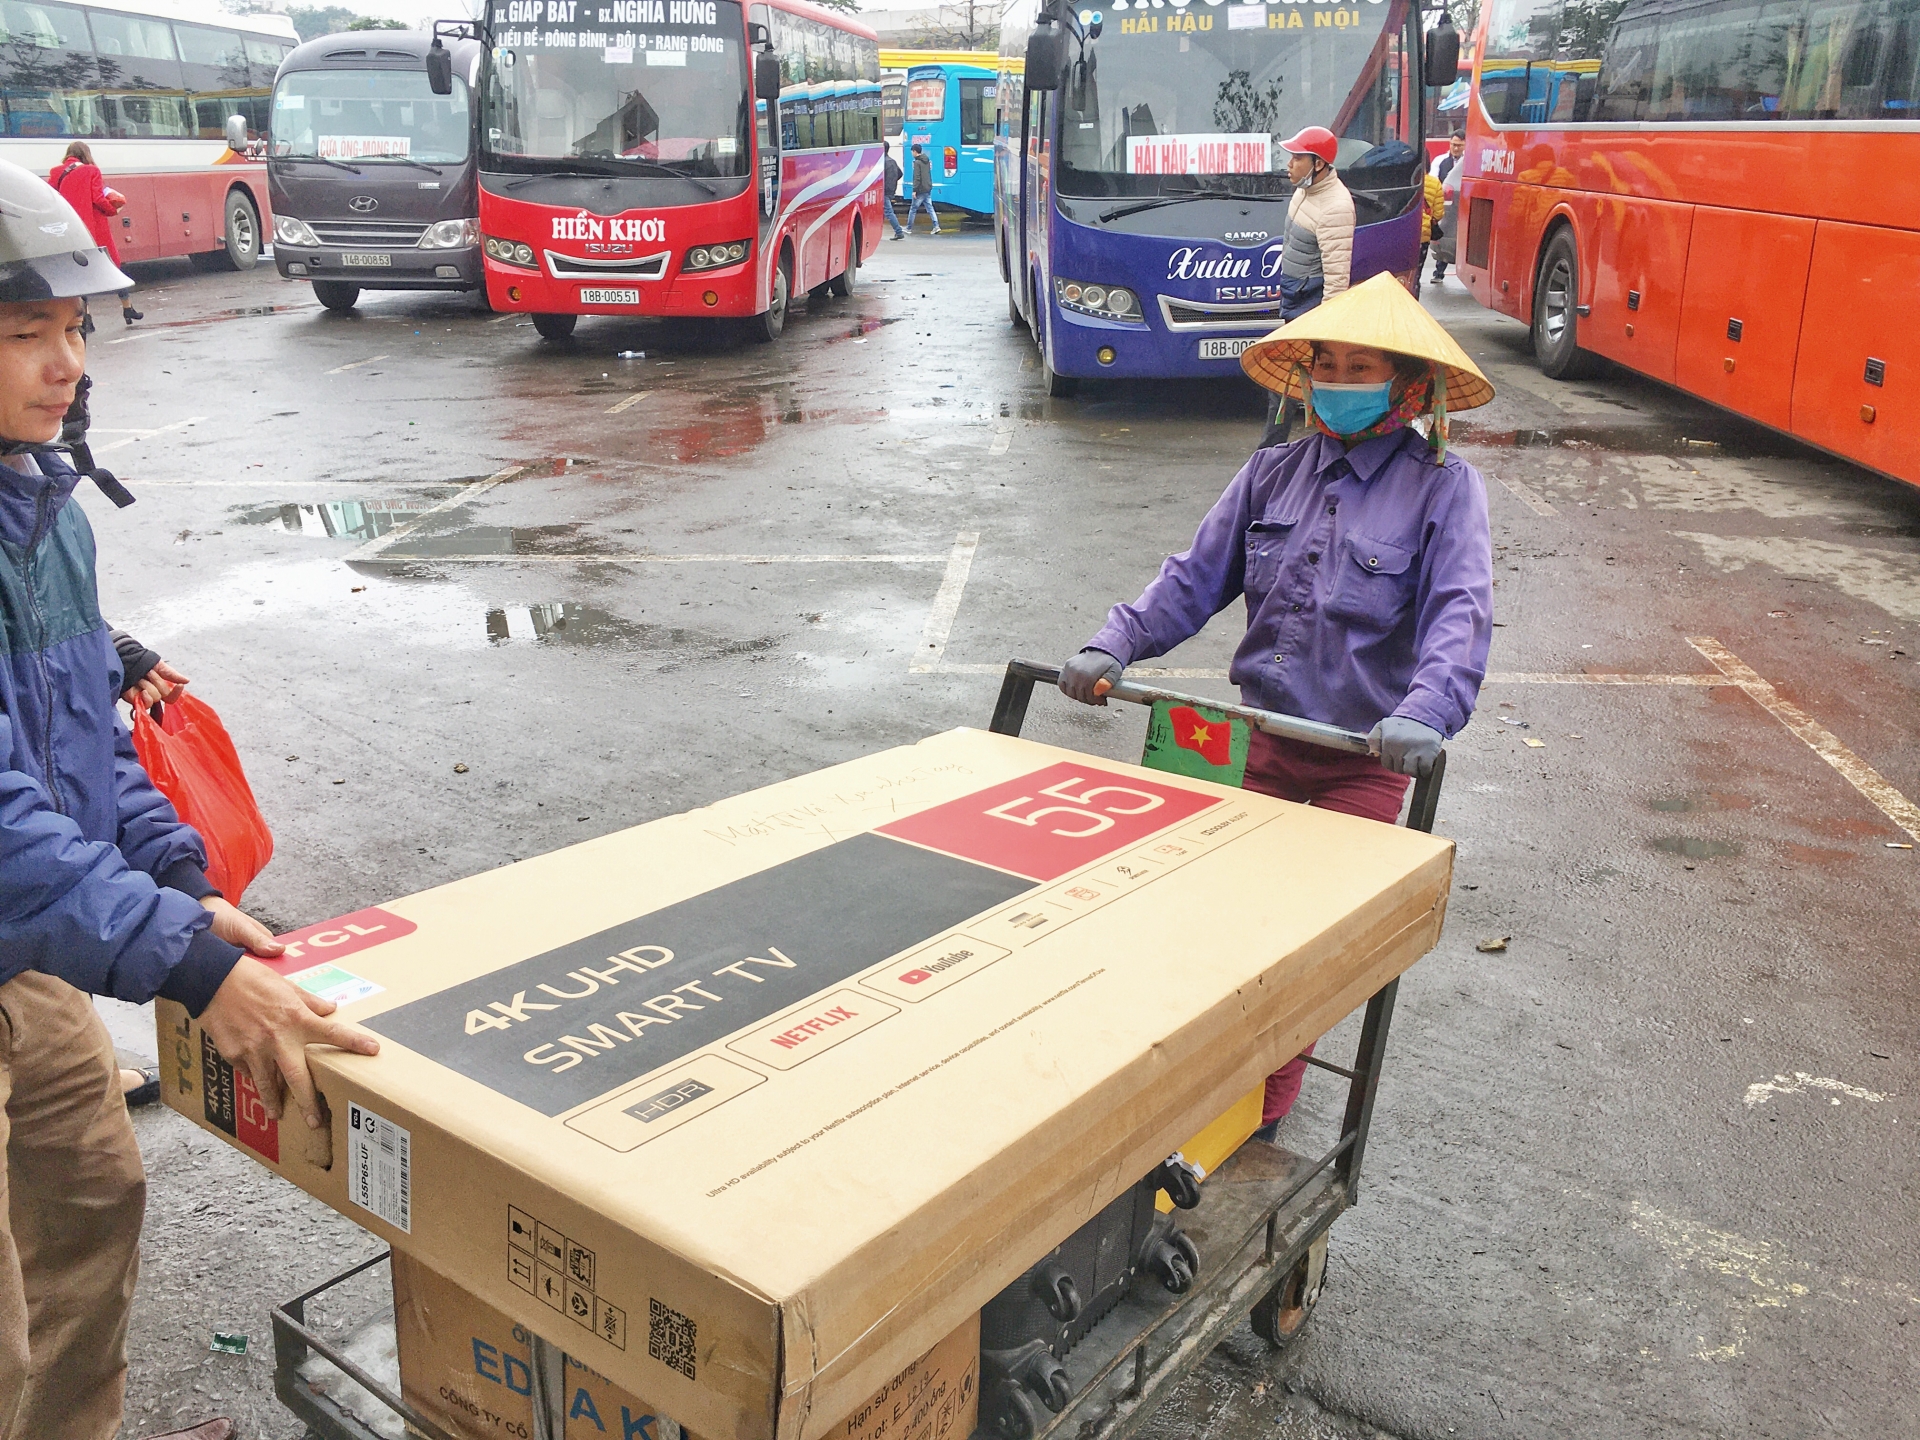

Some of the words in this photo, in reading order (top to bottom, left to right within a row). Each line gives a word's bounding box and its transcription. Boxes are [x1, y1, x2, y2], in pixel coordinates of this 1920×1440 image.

[1121, 12, 1158, 34] HẢI
[1166, 8, 1213, 35] HẬU
[1268, 9, 1304, 29] HÀ
[1314, 7, 1359, 30] NỘI
[545, 29, 576, 48] ĐÔNG
[579, 29, 607, 48] BÌNH
[639, 34, 647, 49] 9
[691, 34, 724, 53] ĐÔNG
[1134, 137, 1157, 174] HẢI
[1198, 143, 1228, 174] NAM
[552, 210, 604, 240] HIỀN
[609, 218, 666, 241] KHƠI
[1224, 231, 1268, 241] SAMCO
[344, 255, 390, 266] 14B-008.53
[585, 243, 633, 253] ISUZU
[1167, 247, 1251, 280] Xuân
[583, 290, 637, 303] 18B-005.51
[1216, 285, 1281, 300] ISUZU
[981, 776, 1166, 839] 55
[284, 915, 387, 958] TCL
[920, 948, 974, 976] YouTube
[464, 989, 562, 1036] 4K
[535, 944, 675, 999] UHD
[523, 979, 724, 1074] SMART
[711, 946, 798, 983] TV
[770, 1005, 859, 1050] NETFLIX
[176, 1018, 193, 1095] TCL
[208, 1085, 219, 1114] 4K
[221, 1066, 232, 1121] SMART
[634, 1082, 707, 1119] HDR
[361, 1141, 369, 1207] L55P65-UF
[706, 1185, 727, 1198] Ultra
[725, 1177, 740, 1187] HD
[740, 1157, 778, 1180] availability
[776, 1142, 803, 1159] subject
[808, 1129, 825, 1141] your
[823, 1117, 847, 1132] Netflix
[439, 1386, 480, 1417] CÔNG
[481, 1409, 501, 1427] TY
[847, 1405, 872, 1436] Hạn
[875, 1385, 891, 1410] sử
[893, 1401, 901, 1422] E
